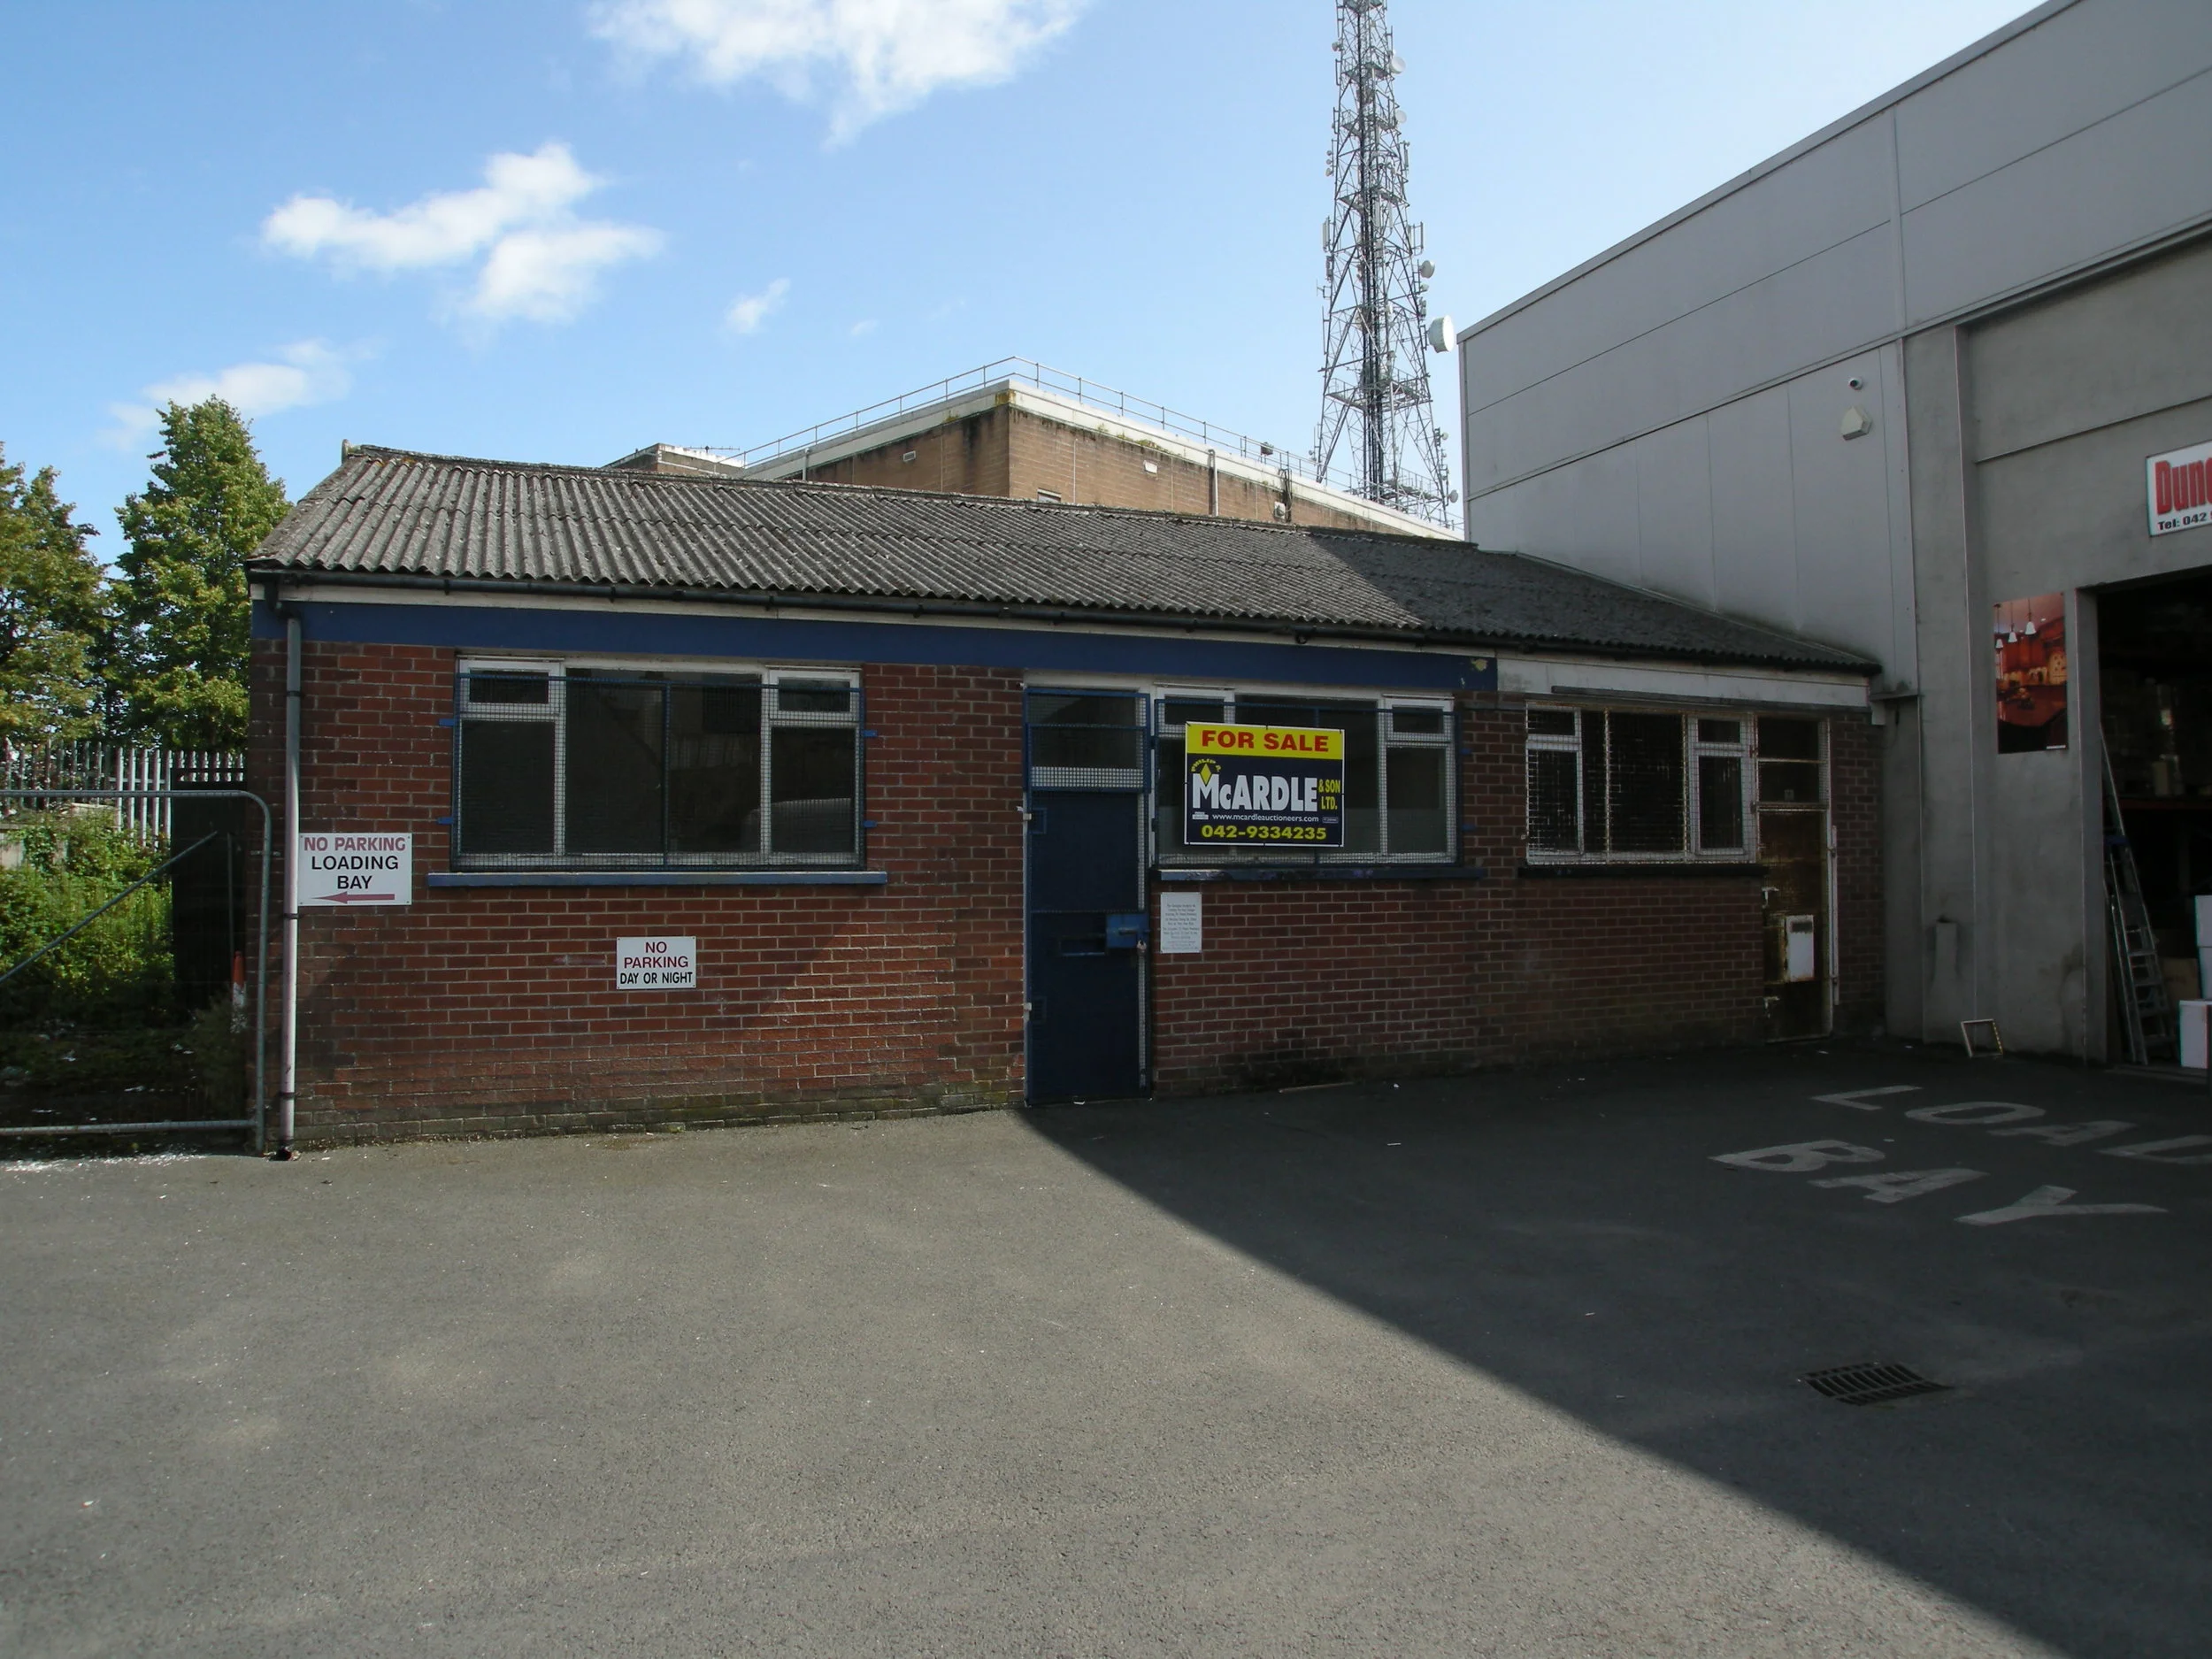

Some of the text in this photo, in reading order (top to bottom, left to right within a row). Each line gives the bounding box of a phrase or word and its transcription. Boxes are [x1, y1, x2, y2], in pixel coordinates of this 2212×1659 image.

[2157, 518, 2180, 531] Tel:
[2183, 512, 2207, 526] 042
[1202, 730, 1330, 752] FOR SALE
[1192, 772, 1317, 812] McARDLE
[1318, 779, 1340, 793] & SON
[1321, 796, 1338, 810] LTD.
[1212, 813, 1319, 823] www.mcardleauctioneers.com
[1202, 825, 1327, 840] 042-9334235
[304, 837, 406, 851] NO PARKING
[311, 856, 398, 870] LOADING
[337, 875, 373, 889] BAY
[645, 941, 667, 954] NO
[624, 956, 688, 969] PARKING
[620, 972, 693, 984] DAY OR NIGHT
[1707, 1139, 2169, 1226] BAY
